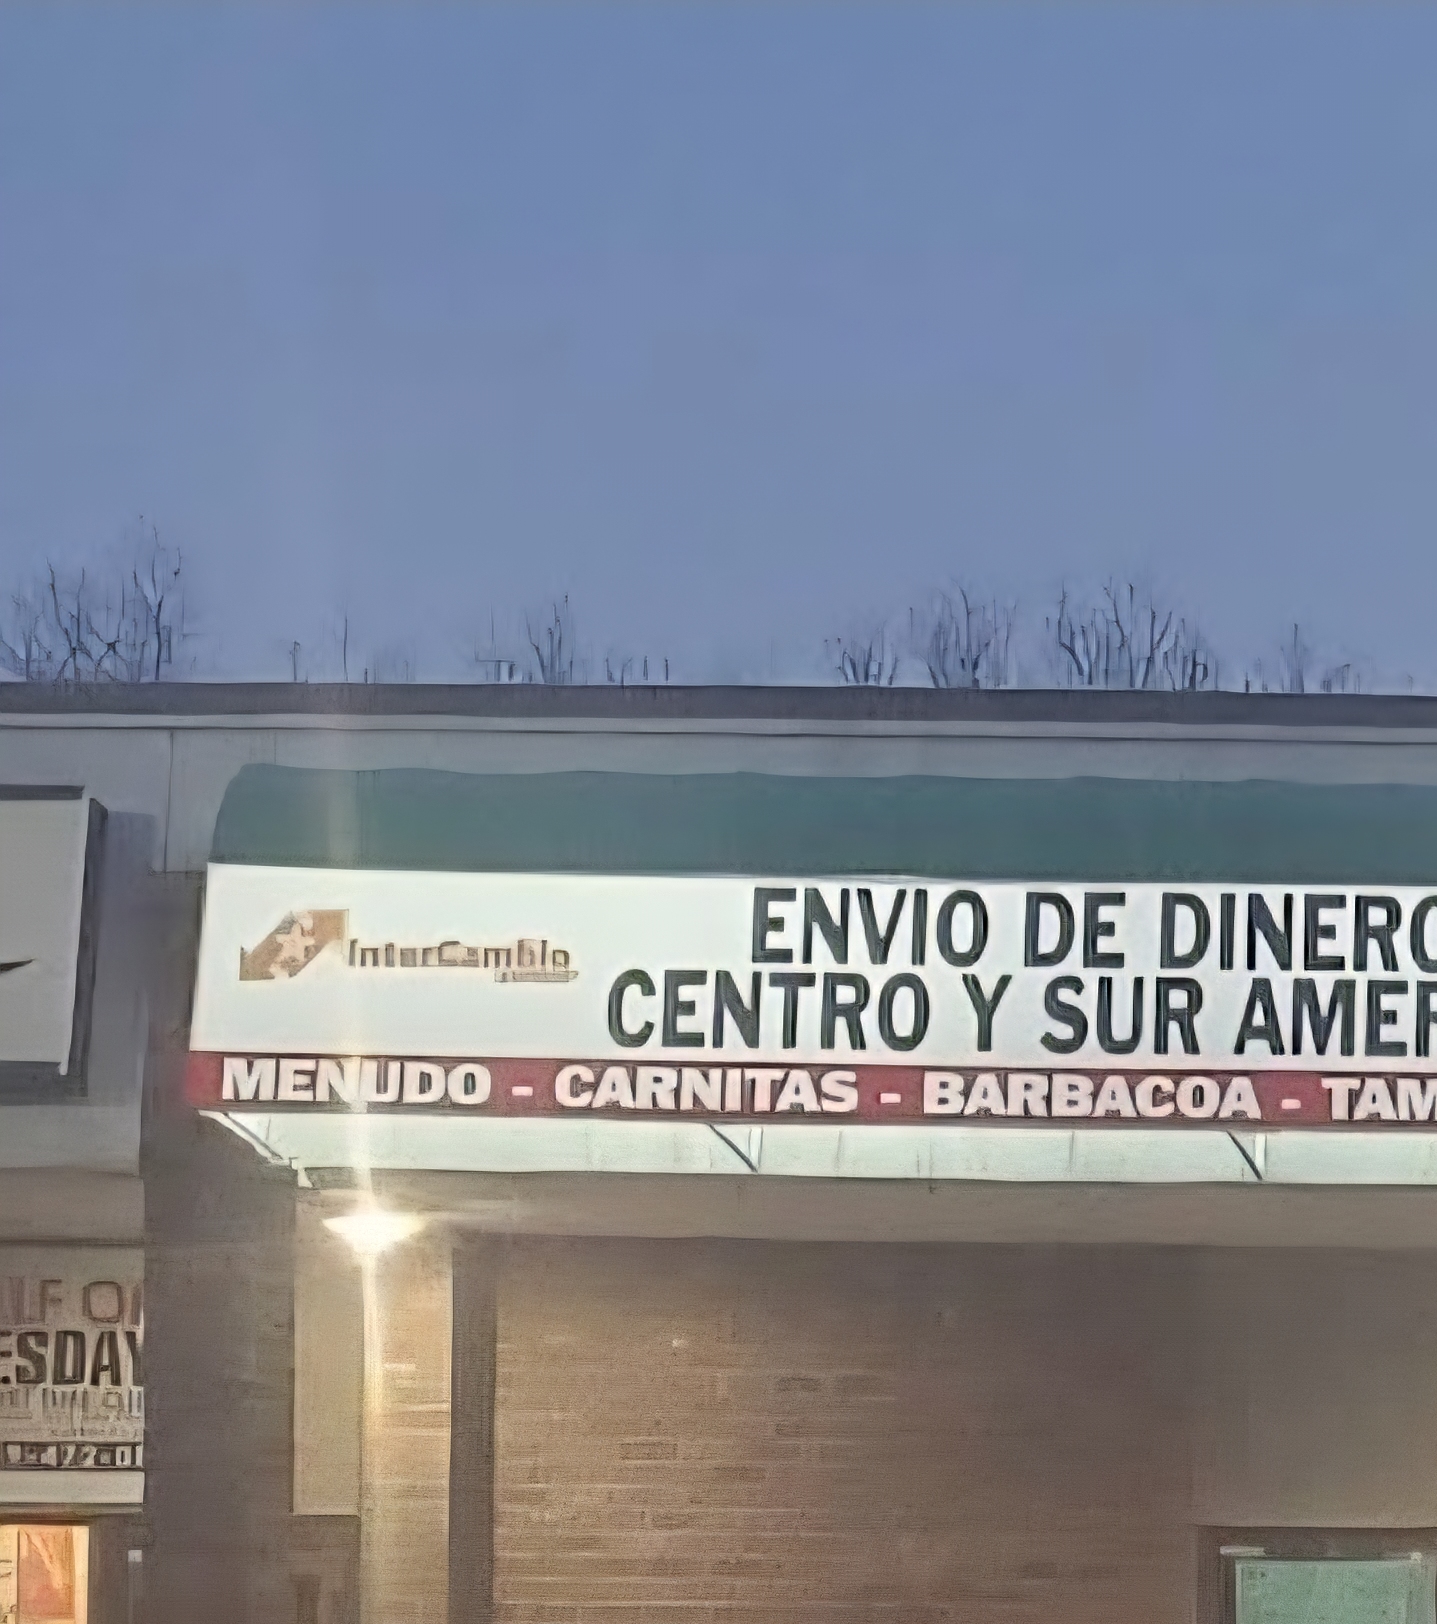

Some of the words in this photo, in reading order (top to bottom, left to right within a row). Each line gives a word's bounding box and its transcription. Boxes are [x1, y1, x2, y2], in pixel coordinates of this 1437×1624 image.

[752, 887, 988, 966] ENVIO
[1024, 891, 1126, 969] DE
[607, 969, 930, 1051] CENTRO
[962, 974, 1012, 1052] Y
[1040, 976, 1203, 1056] SUR
[221, 1056, 491, 1106] MENUDO
[554, 1064, 859, 1114] CARNITAS
[923, 1071, 1262, 1119] BARBACOA
